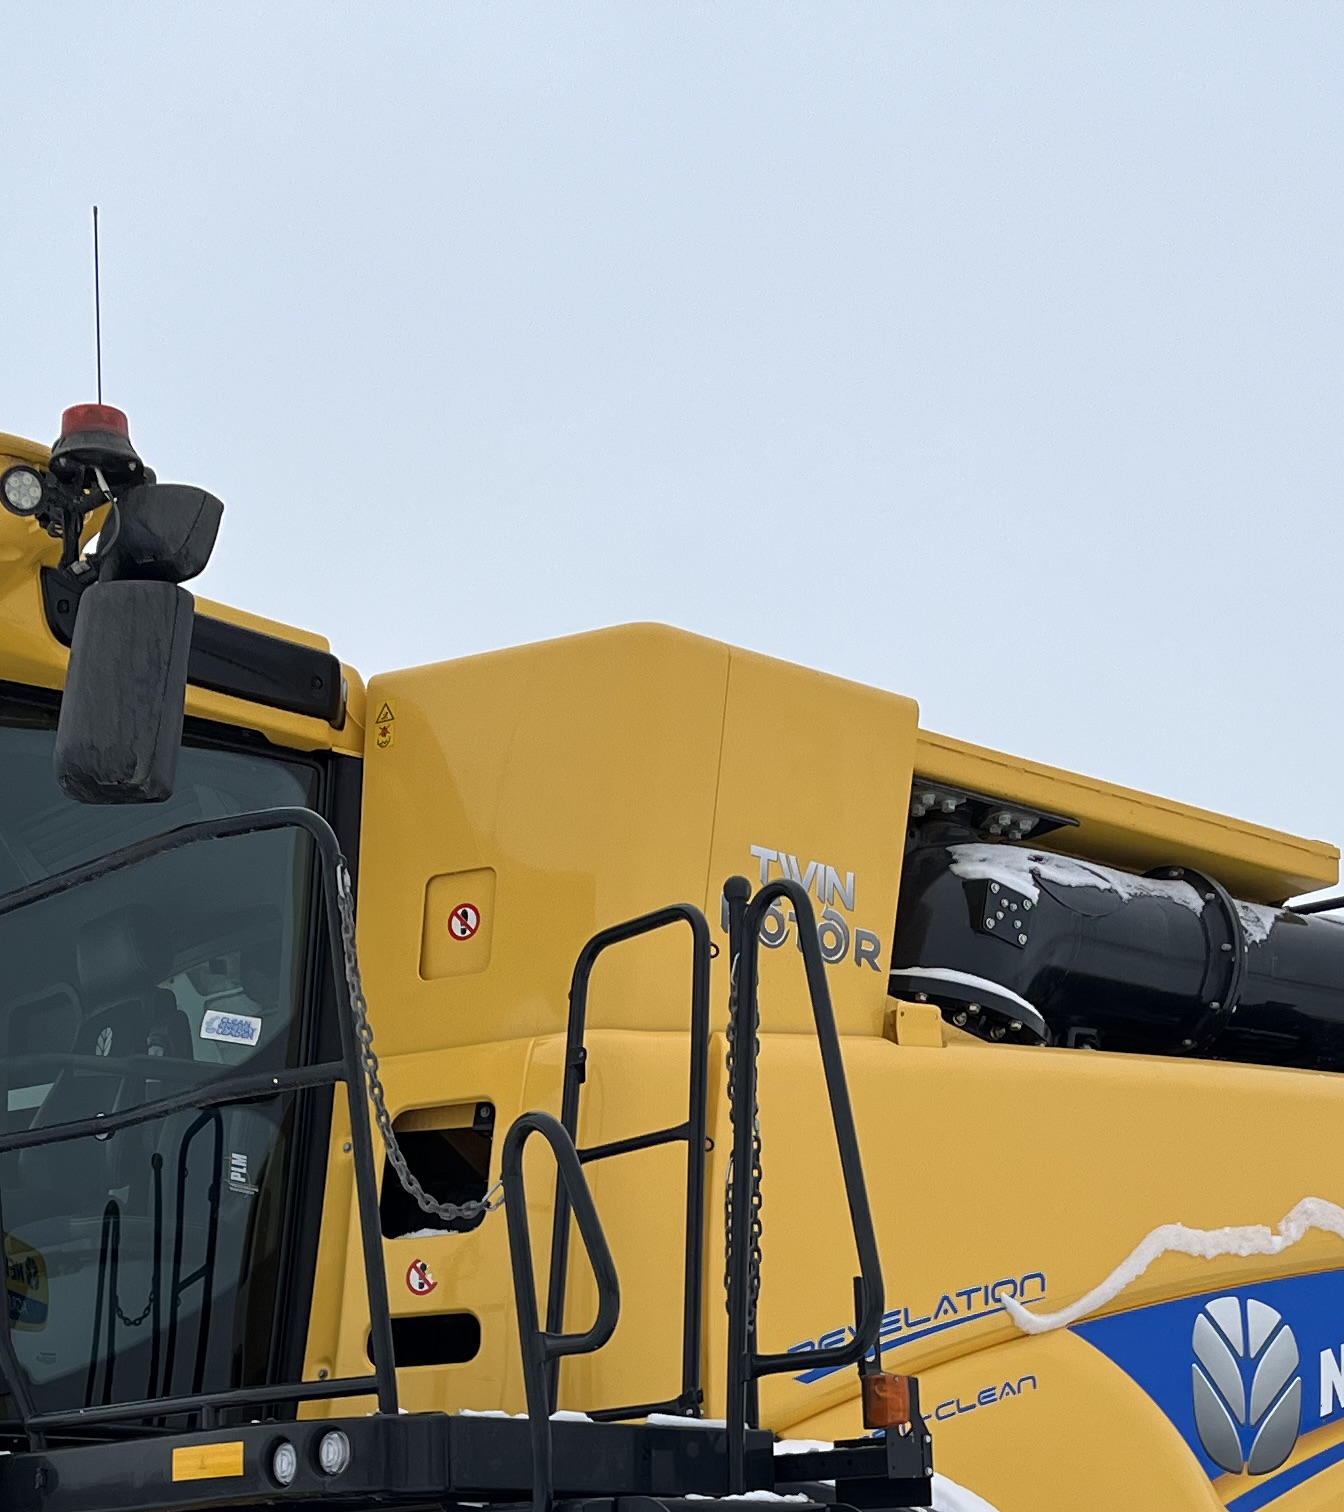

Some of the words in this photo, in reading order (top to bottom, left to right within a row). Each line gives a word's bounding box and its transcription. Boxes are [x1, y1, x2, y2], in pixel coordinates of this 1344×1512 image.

[750, 843, 854, 912] TWIN
[720, 890, 882, 972] OOR
[230, 1152, 248, 1183] PLM
